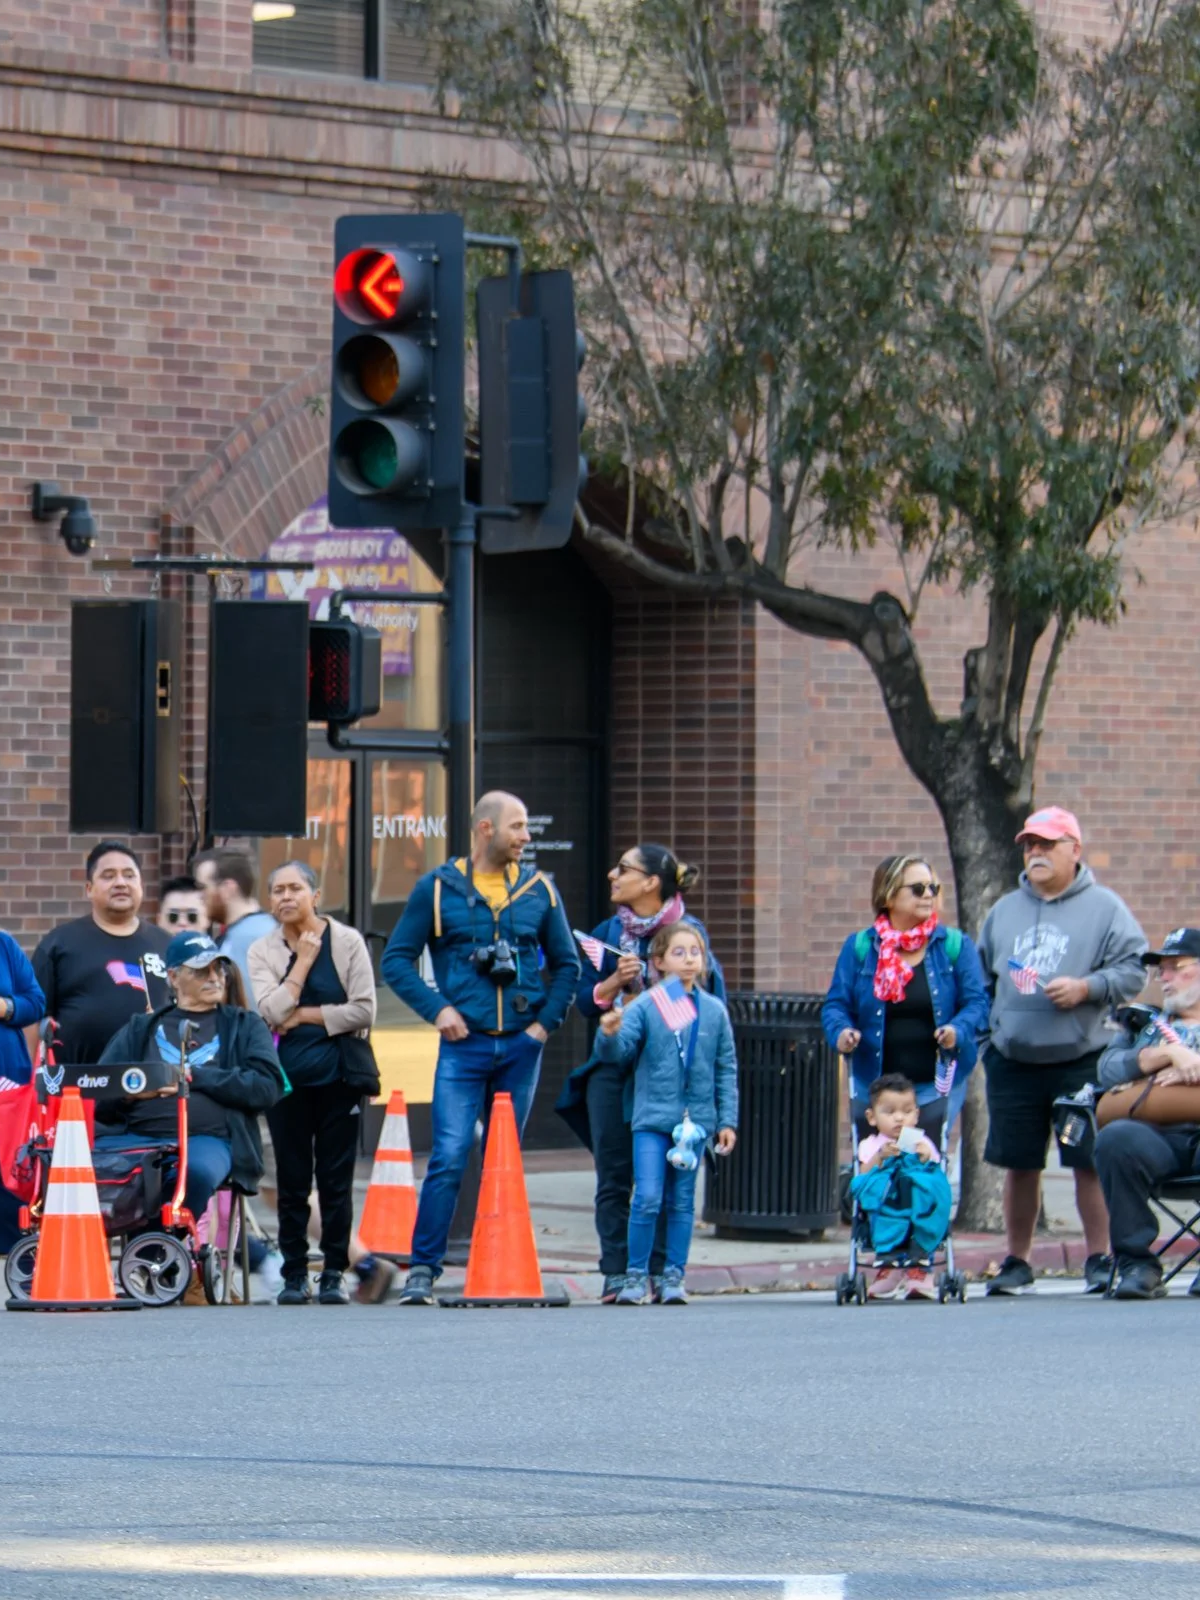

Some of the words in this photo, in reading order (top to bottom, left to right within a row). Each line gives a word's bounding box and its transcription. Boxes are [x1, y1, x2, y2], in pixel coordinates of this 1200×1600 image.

[363, 611, 419, 632] Authority
[372, 814, 448, 839] ENTRANC
[77, 1073, 110, 1088] drive
